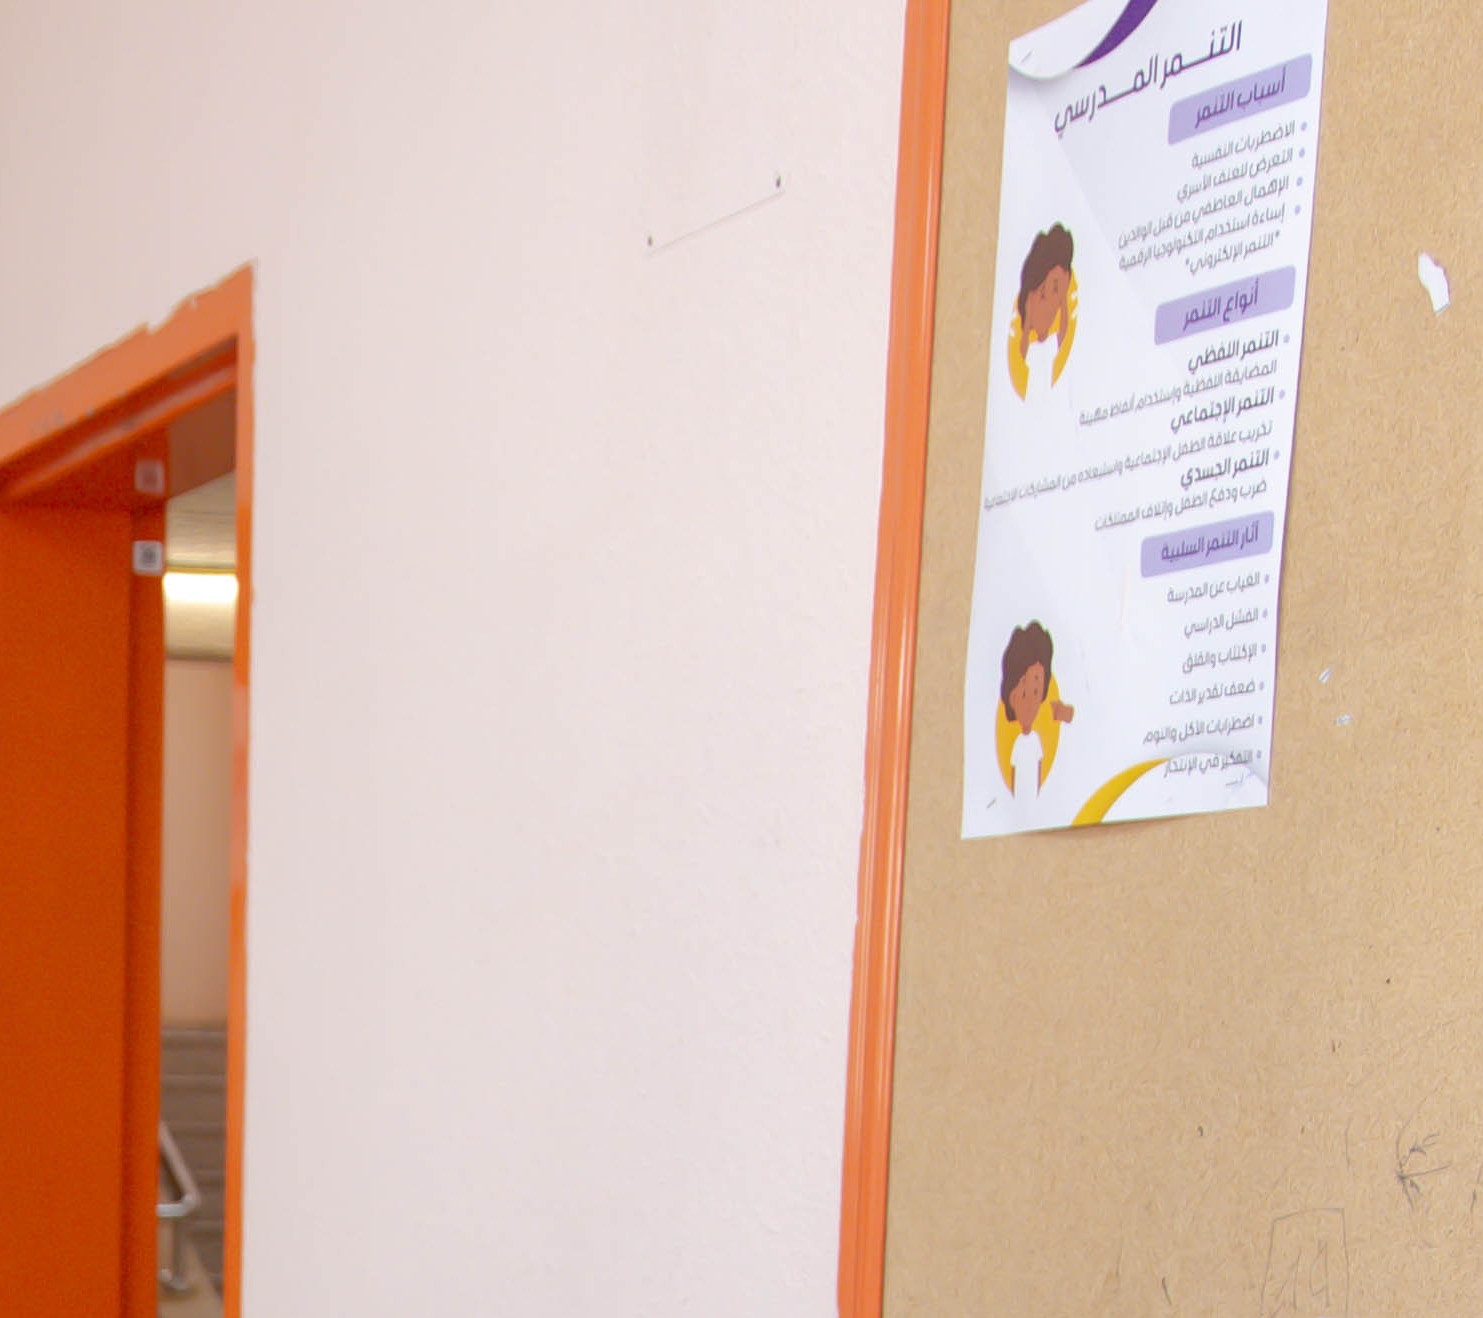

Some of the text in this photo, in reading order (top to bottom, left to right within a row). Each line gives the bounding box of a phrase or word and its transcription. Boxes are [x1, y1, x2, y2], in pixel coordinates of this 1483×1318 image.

[1194, 66, 1286, 128] أسباب التنمر
[1182, 278, 1258, 331] أنواع التنمر
[1240, 329, 1278, 360] التنمر
[1236, 386, 1274, 416] التنمر
[1180, 448, 1269, 490] التنمر الجسدي
[1161, 536, 1204, 562] السلبية
[1205, 529, 1238, 557] التنمر
[1167, 582, 1208, 604] المدرسة
[1209, 581, 1224, 599] عن
[1183, 613, 1224, 639] الدراسي
[1223, 680, 1255, 696] ضعف
